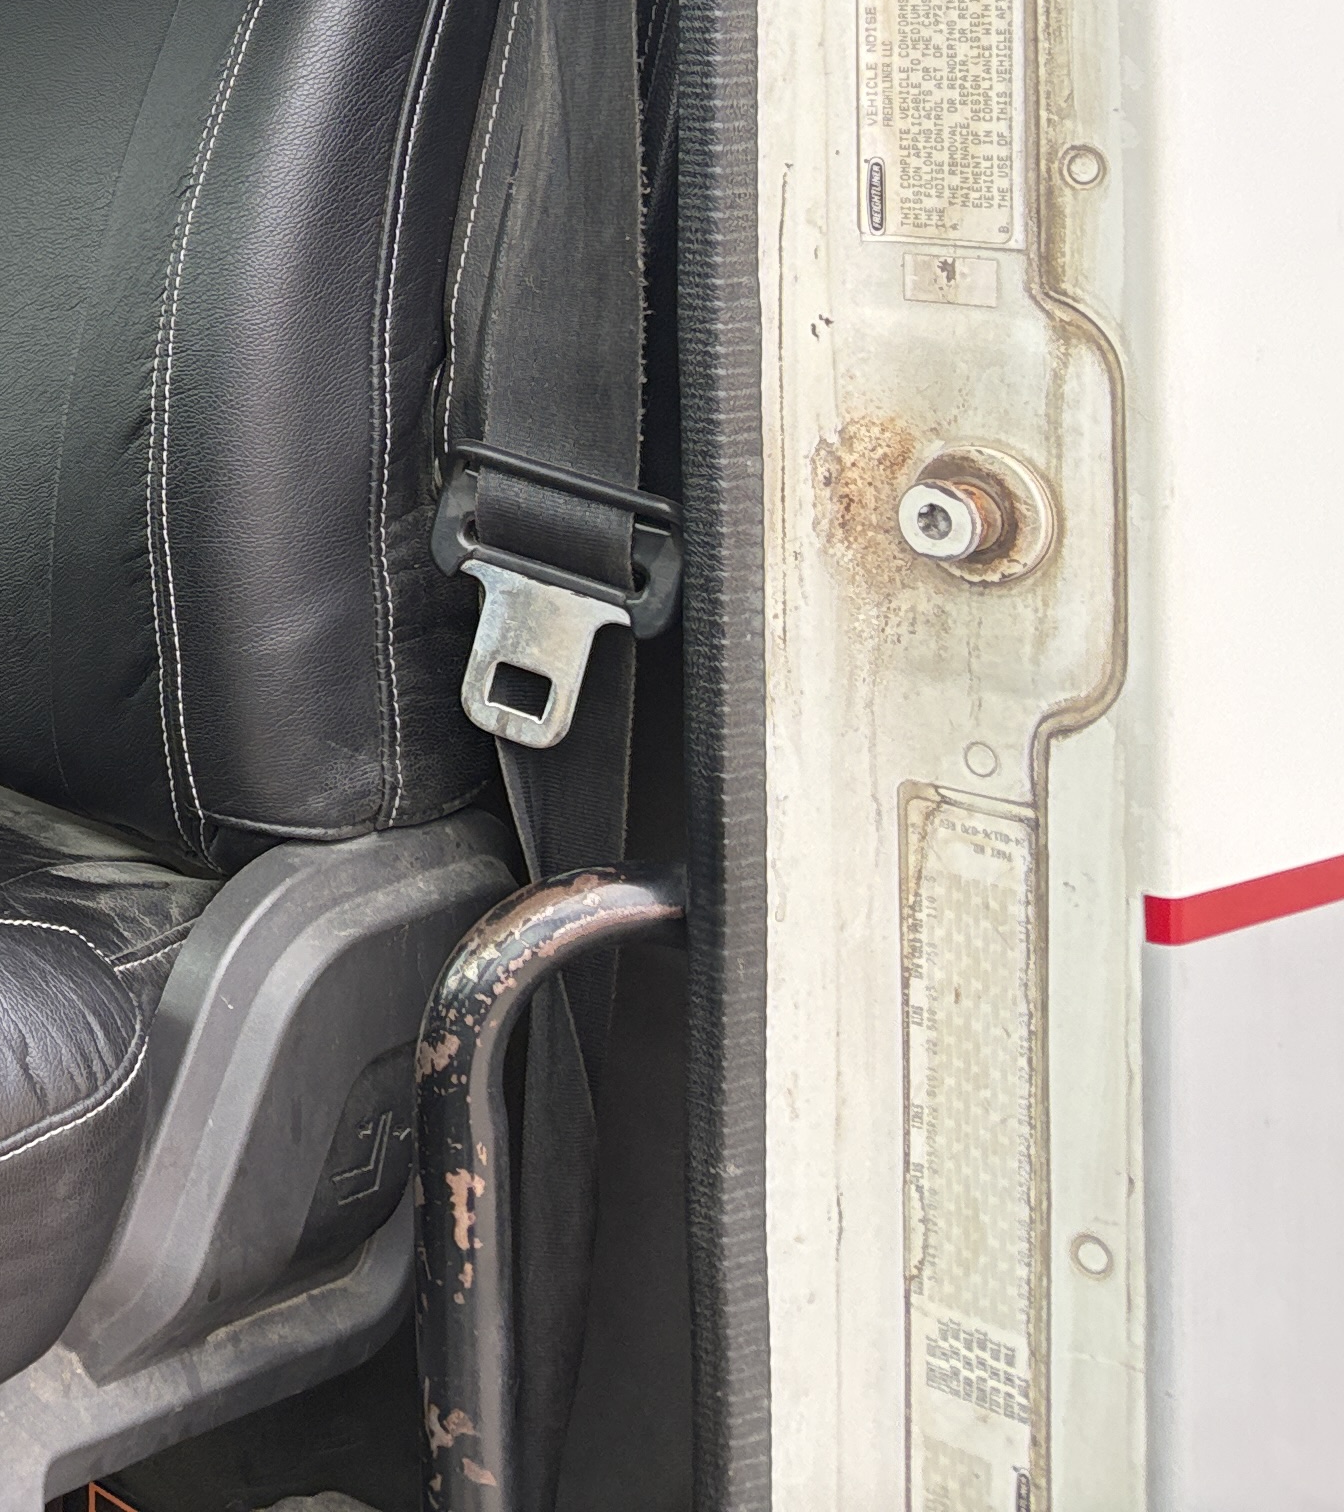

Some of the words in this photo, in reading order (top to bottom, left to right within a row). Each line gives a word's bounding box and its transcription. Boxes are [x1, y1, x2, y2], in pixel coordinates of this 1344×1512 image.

[865, 7, 877, 53] NOISE
[910, 4, 921, 50] MEDIUM
[932, 4, 943, 34] 1972
[981, 4, 992, 35] WITH
[881, 41, 892, 57] LLC
[922, 36, 932, 57] THE
[933, 44, 943, 58] OF
[958, 28, 969, 43] OR
[970, 12, 981, 65] (LISTED
[911, 58, 921, 73] TO
[946, 20, 958, 90] RENDERING
[995, 28, 1007, 83] VEHICLE
[922, 66, 932, 81] OR
[933, 67, 944, 90] ACT
[982, 44, 993, 122] COMPLIANCE
[866, 62, 878, 126] VEHICLE
[882, 62, 894, 127] FREIGHTLINER
[899, 66, 910, 119] VEHICLE
[922, 90, 933, 120] ACTS
[947, 98, 958, 113] OR
[971, 75, 982, 122] DESIGN
[996, 91, 1007, 122] THIS
[911, 82, 922, 158] APPLICABLE
[933, 98, 944, 152] CONTROL
[947, 122, 958, 176] REMOVAL
[971, 130, 982, 145] OF
[983, 130, 993, 145] IN
[997, 131, 1007, 146] OF
[899, 128, 910, 189] COMPLETE
[922, 128, 933, 198] FOLLOWING
[997, 154, 1008, 178] USE
[934, 160, 945, 198] NOISE
[971, 154, 982, 208] ELEMENT
[983, 154, 994, 209] VEHICLE
[870, 163, 882, 229] FREIGHTLINER
[912, 167, 923, 228] EMISSION
[948, 184, 959, 206] THE
[997, 186, 1008, 209] THE
[900, 197, 911, 227] THIS
[923, 207, 934, 229] THE
[935, 207, 945, 229] THE
